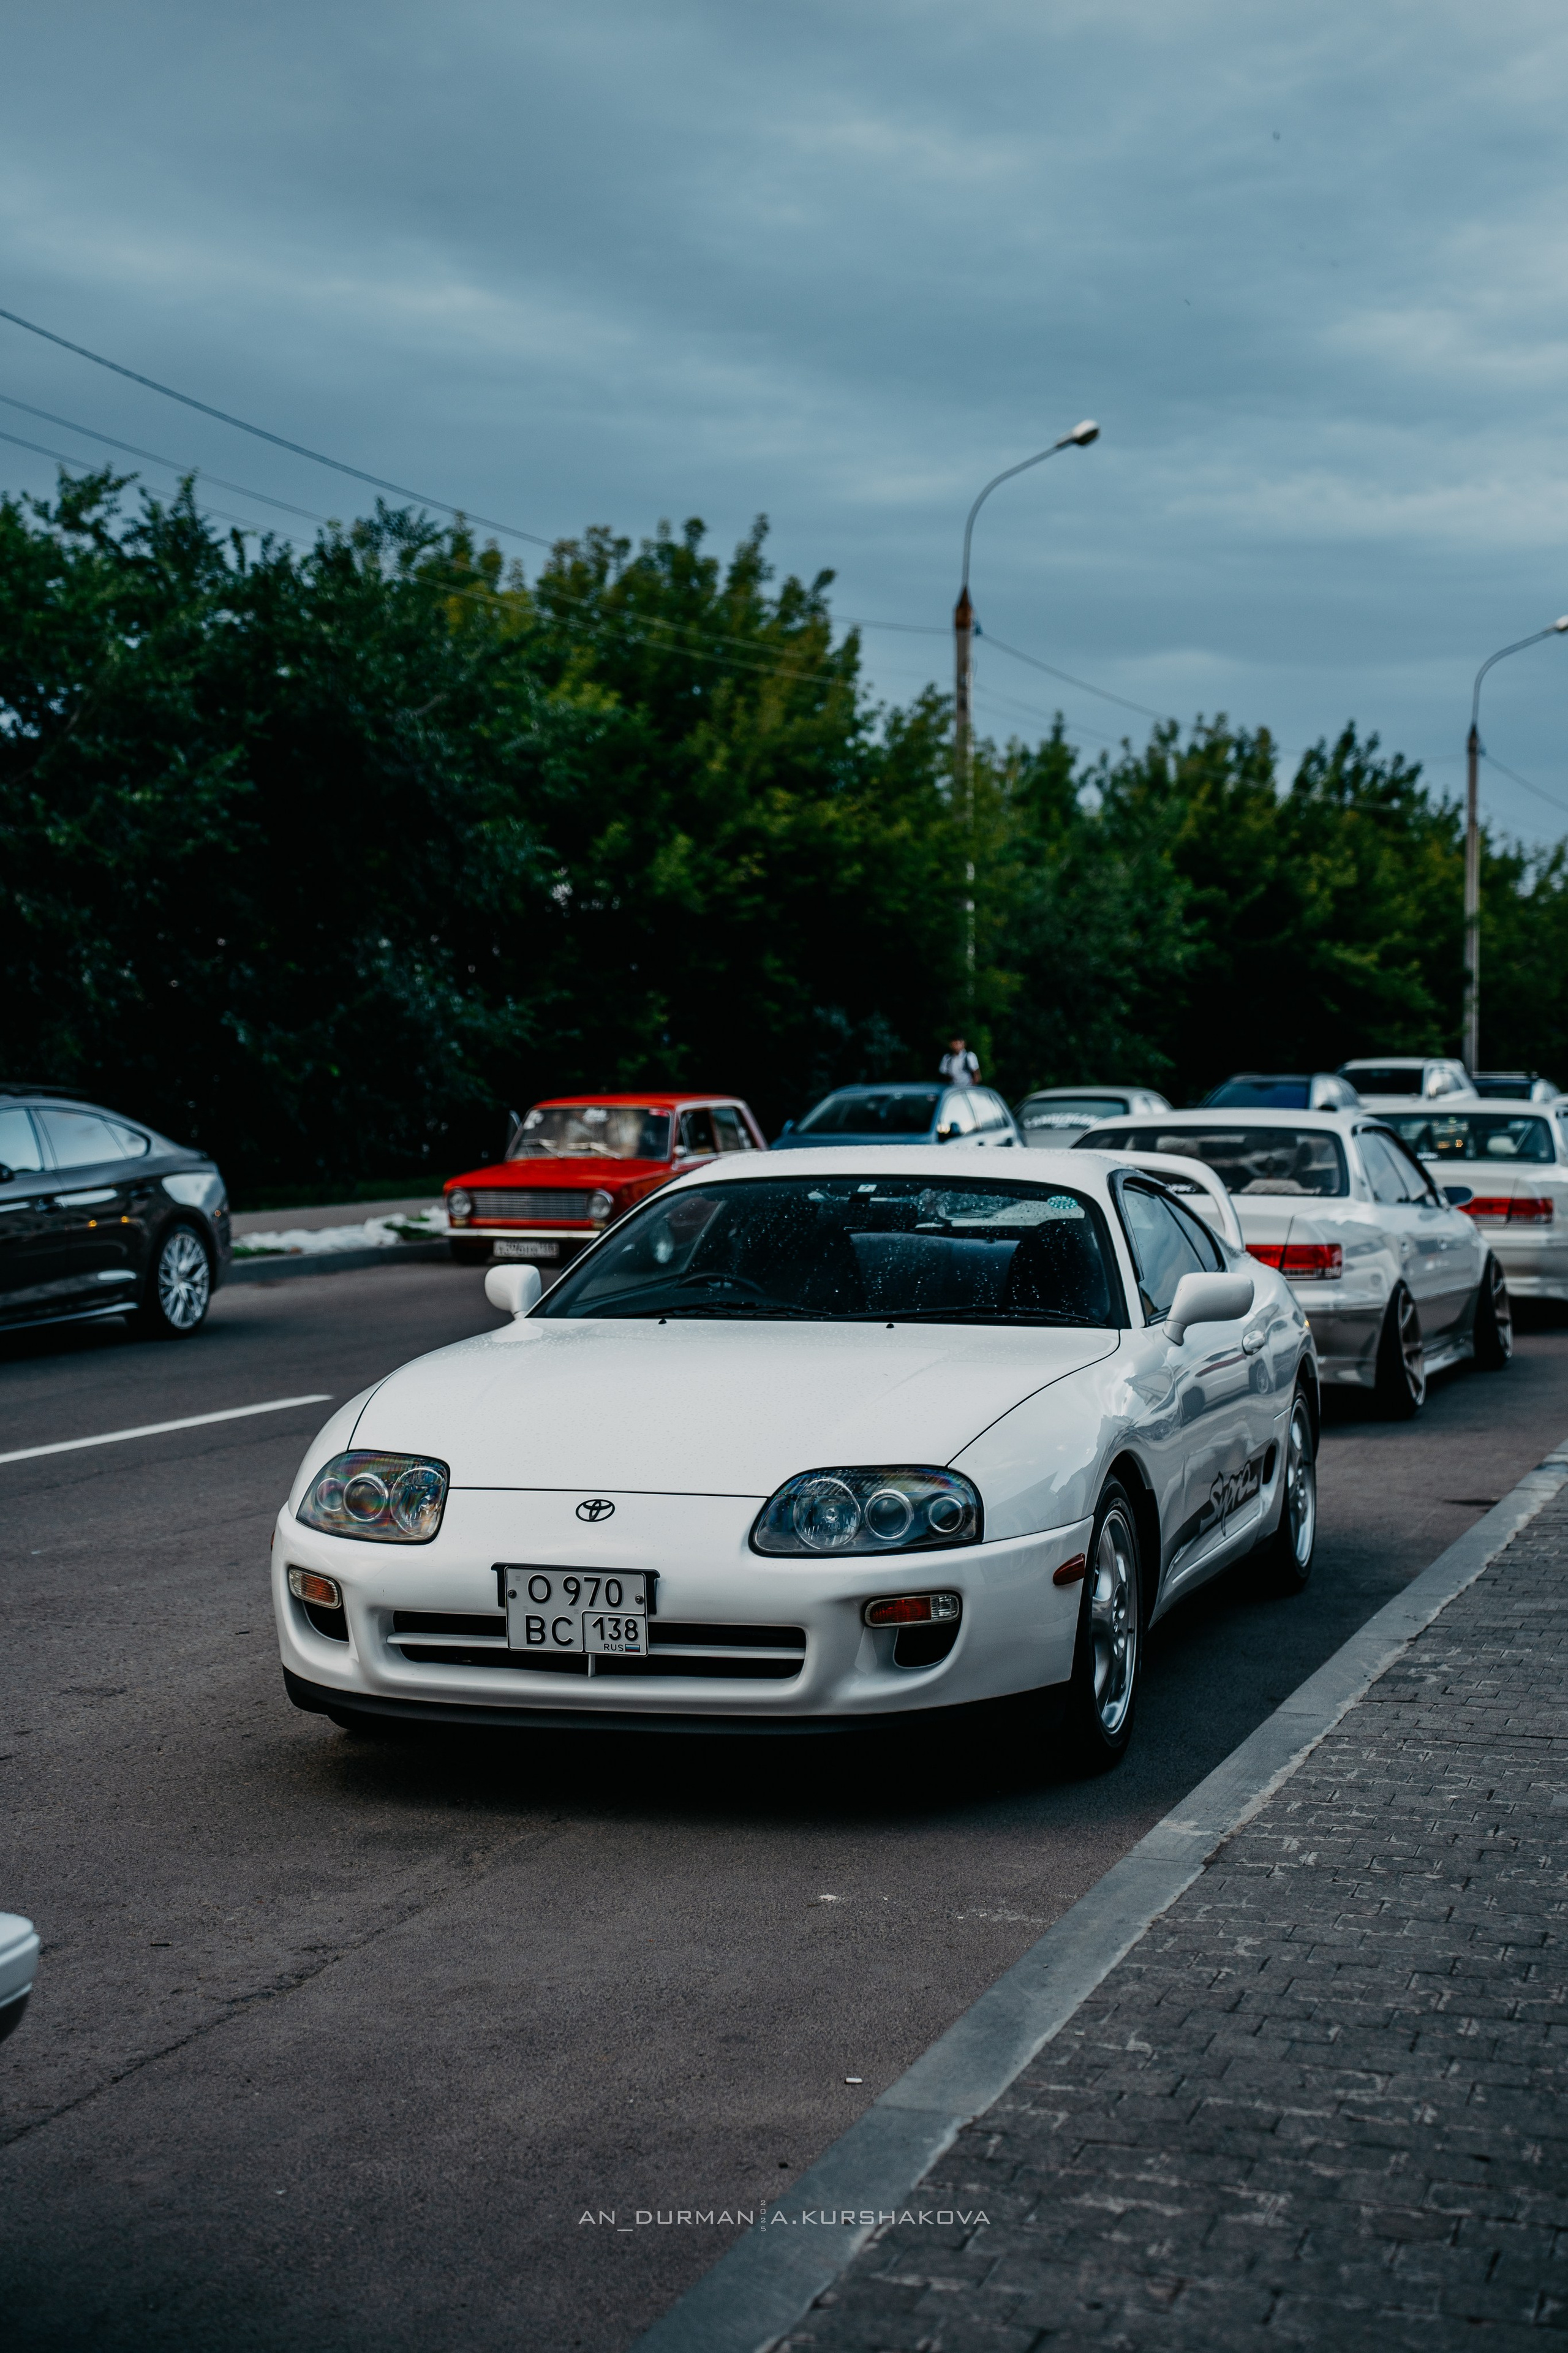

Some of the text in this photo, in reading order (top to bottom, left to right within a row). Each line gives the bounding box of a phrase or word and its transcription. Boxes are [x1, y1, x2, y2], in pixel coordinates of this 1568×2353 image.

[1199, 1460, 1258, 1536] Supra
[563, 1576, 622, 1607] 970
[592, 1616, 638, 1641] 138
